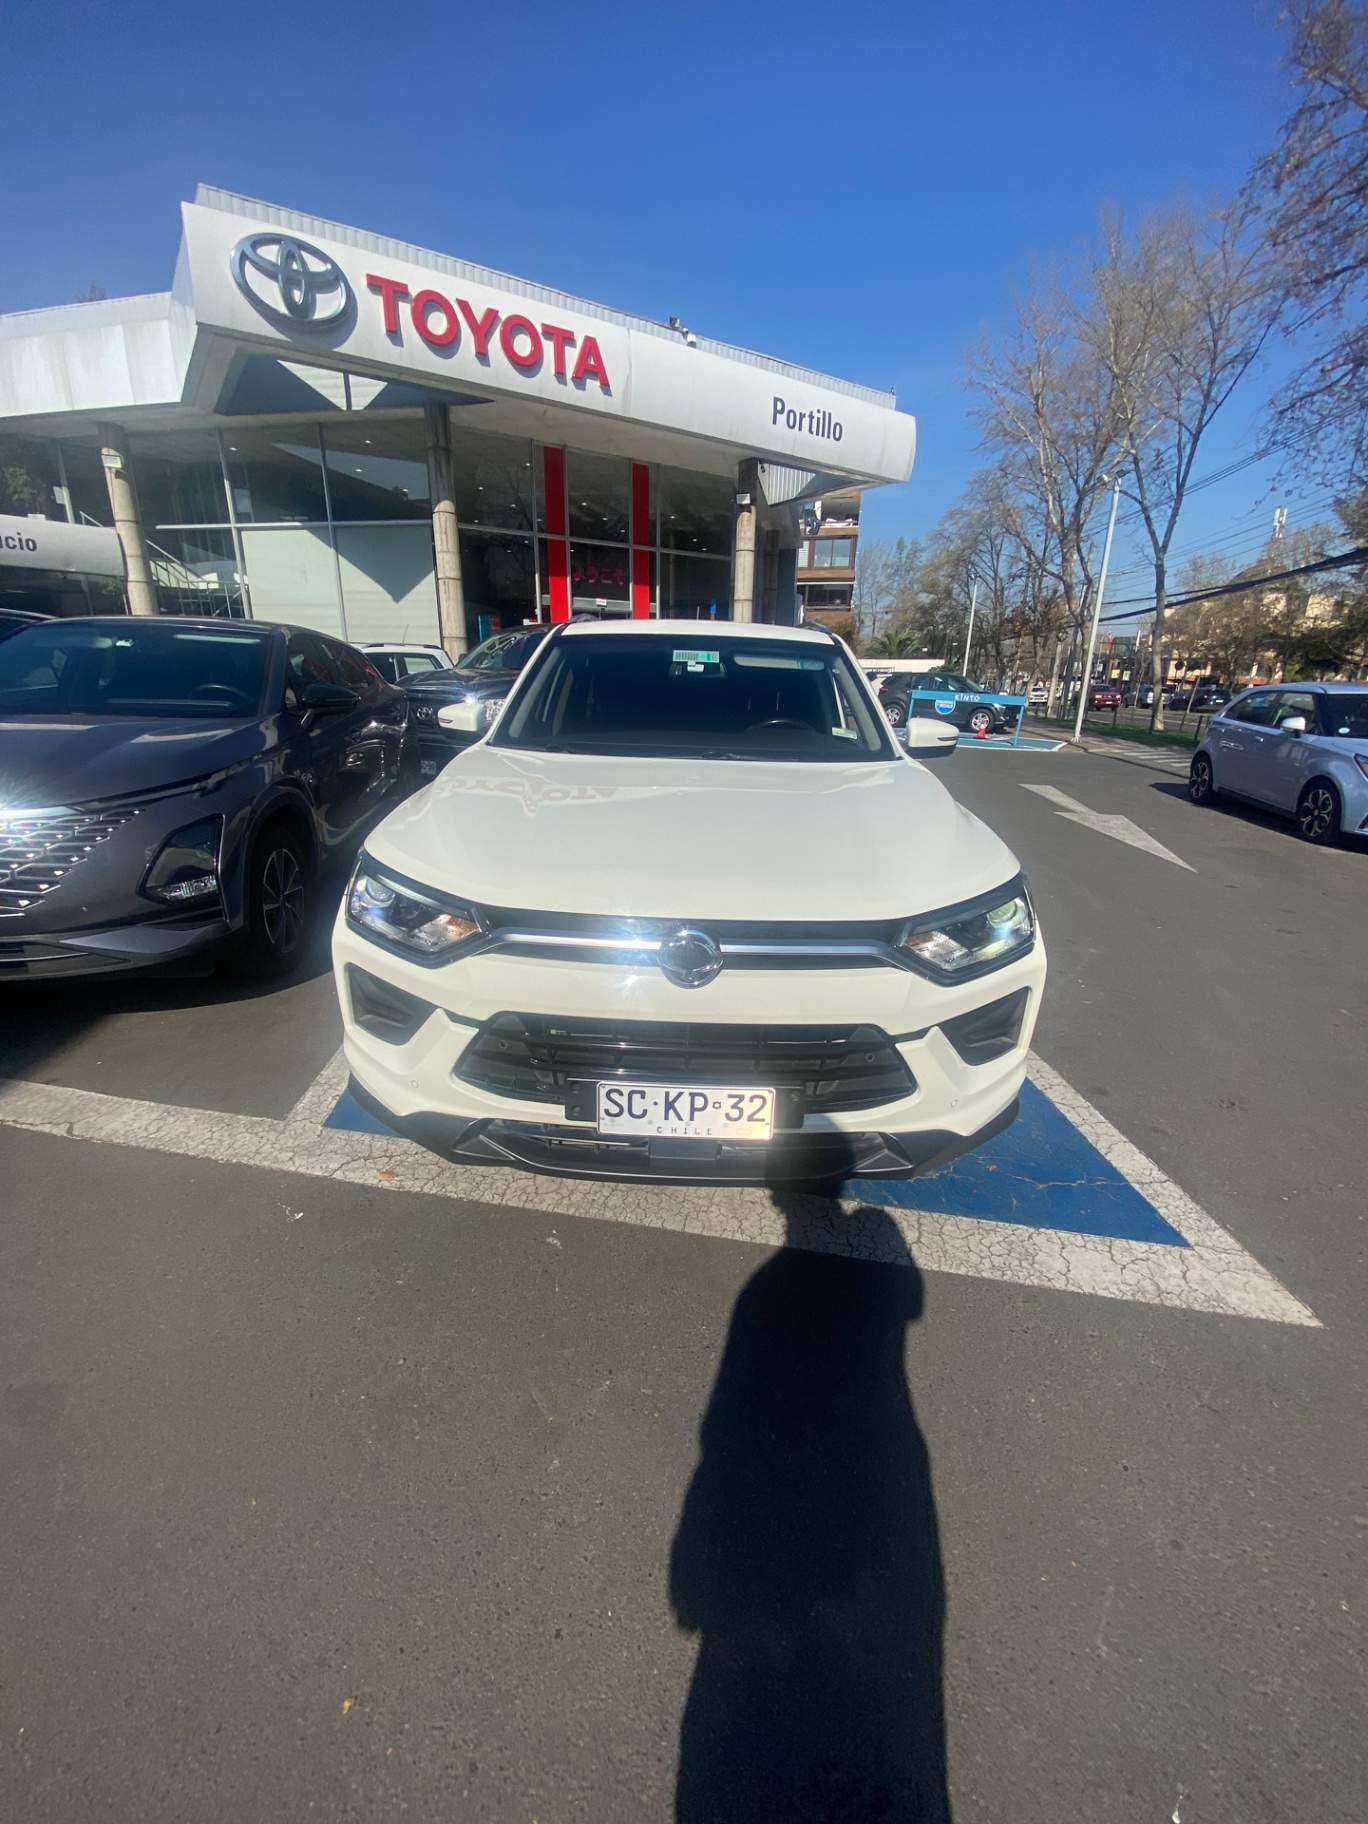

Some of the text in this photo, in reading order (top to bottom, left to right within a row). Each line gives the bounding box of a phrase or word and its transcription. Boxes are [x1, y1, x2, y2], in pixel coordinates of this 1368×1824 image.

[366, 273, 610, 390] TOYOTA
[772, 396, 843, 442] Portillo
[0, 532, 37, 552] cio
[656, 1126, 713, 1136] CHILE
